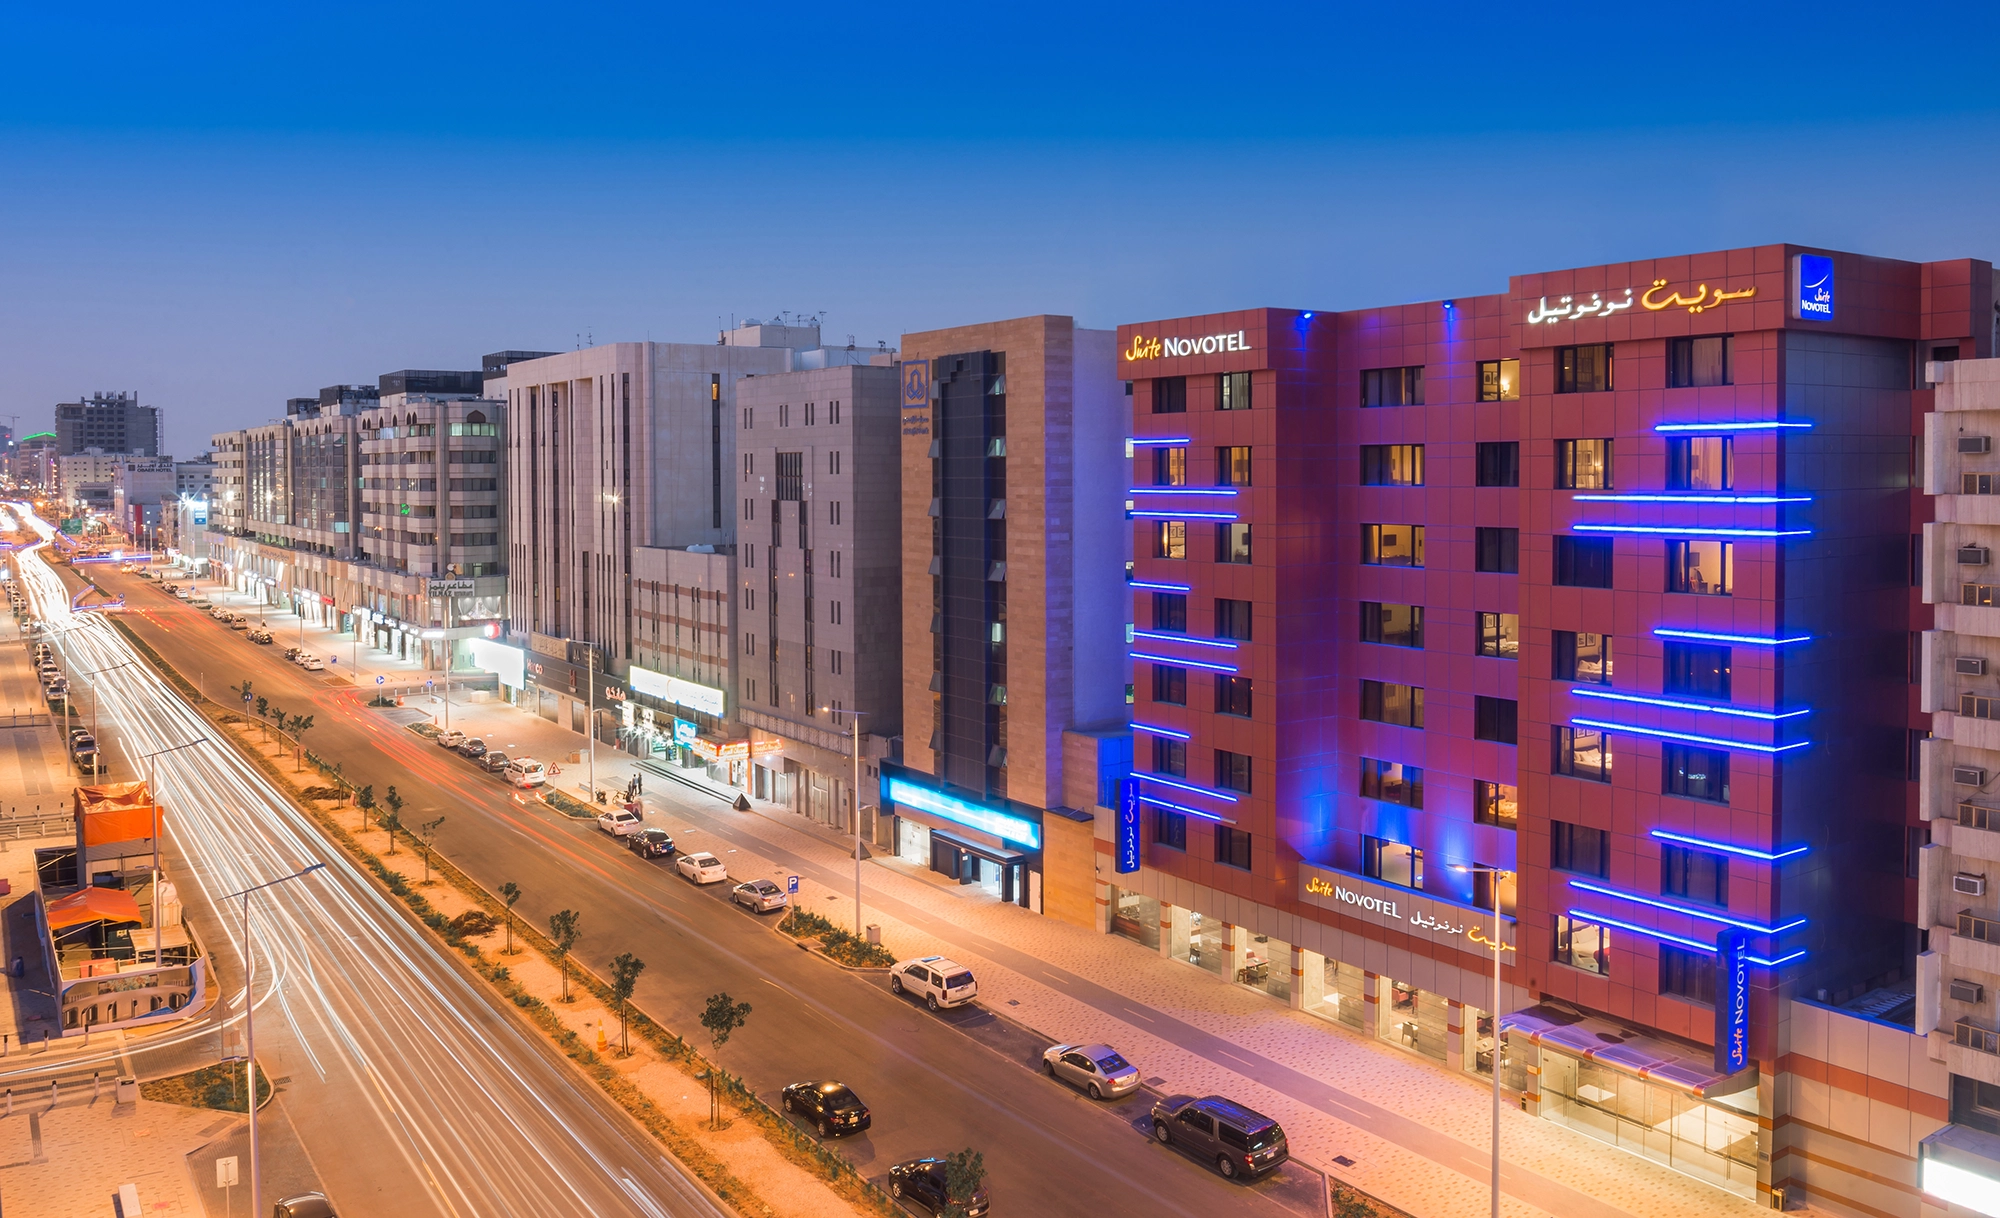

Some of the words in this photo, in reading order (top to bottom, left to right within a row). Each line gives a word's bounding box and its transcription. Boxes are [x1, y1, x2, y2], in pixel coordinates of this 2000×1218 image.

[1527, 288, 1633, 324] نوفوتيل
[1641, 279, 1756, 314] سويت
[1801, 299, 1831, 314] NOVOTEL
[1814, 287, 1831, 303] Suite
[1125, 335, 1161, 361] Suite
[1164, 330, 1252, 358] NOVOTEL
[789, 877, 797, 889] P
[1305, 877, 1333, 896] Suite
[1335, 886, 1402, 919] NOVOTEL
[1734, 937, 1746, 1025] NOVOTEL
[1731, 1027, 1744, 1066] Suite
